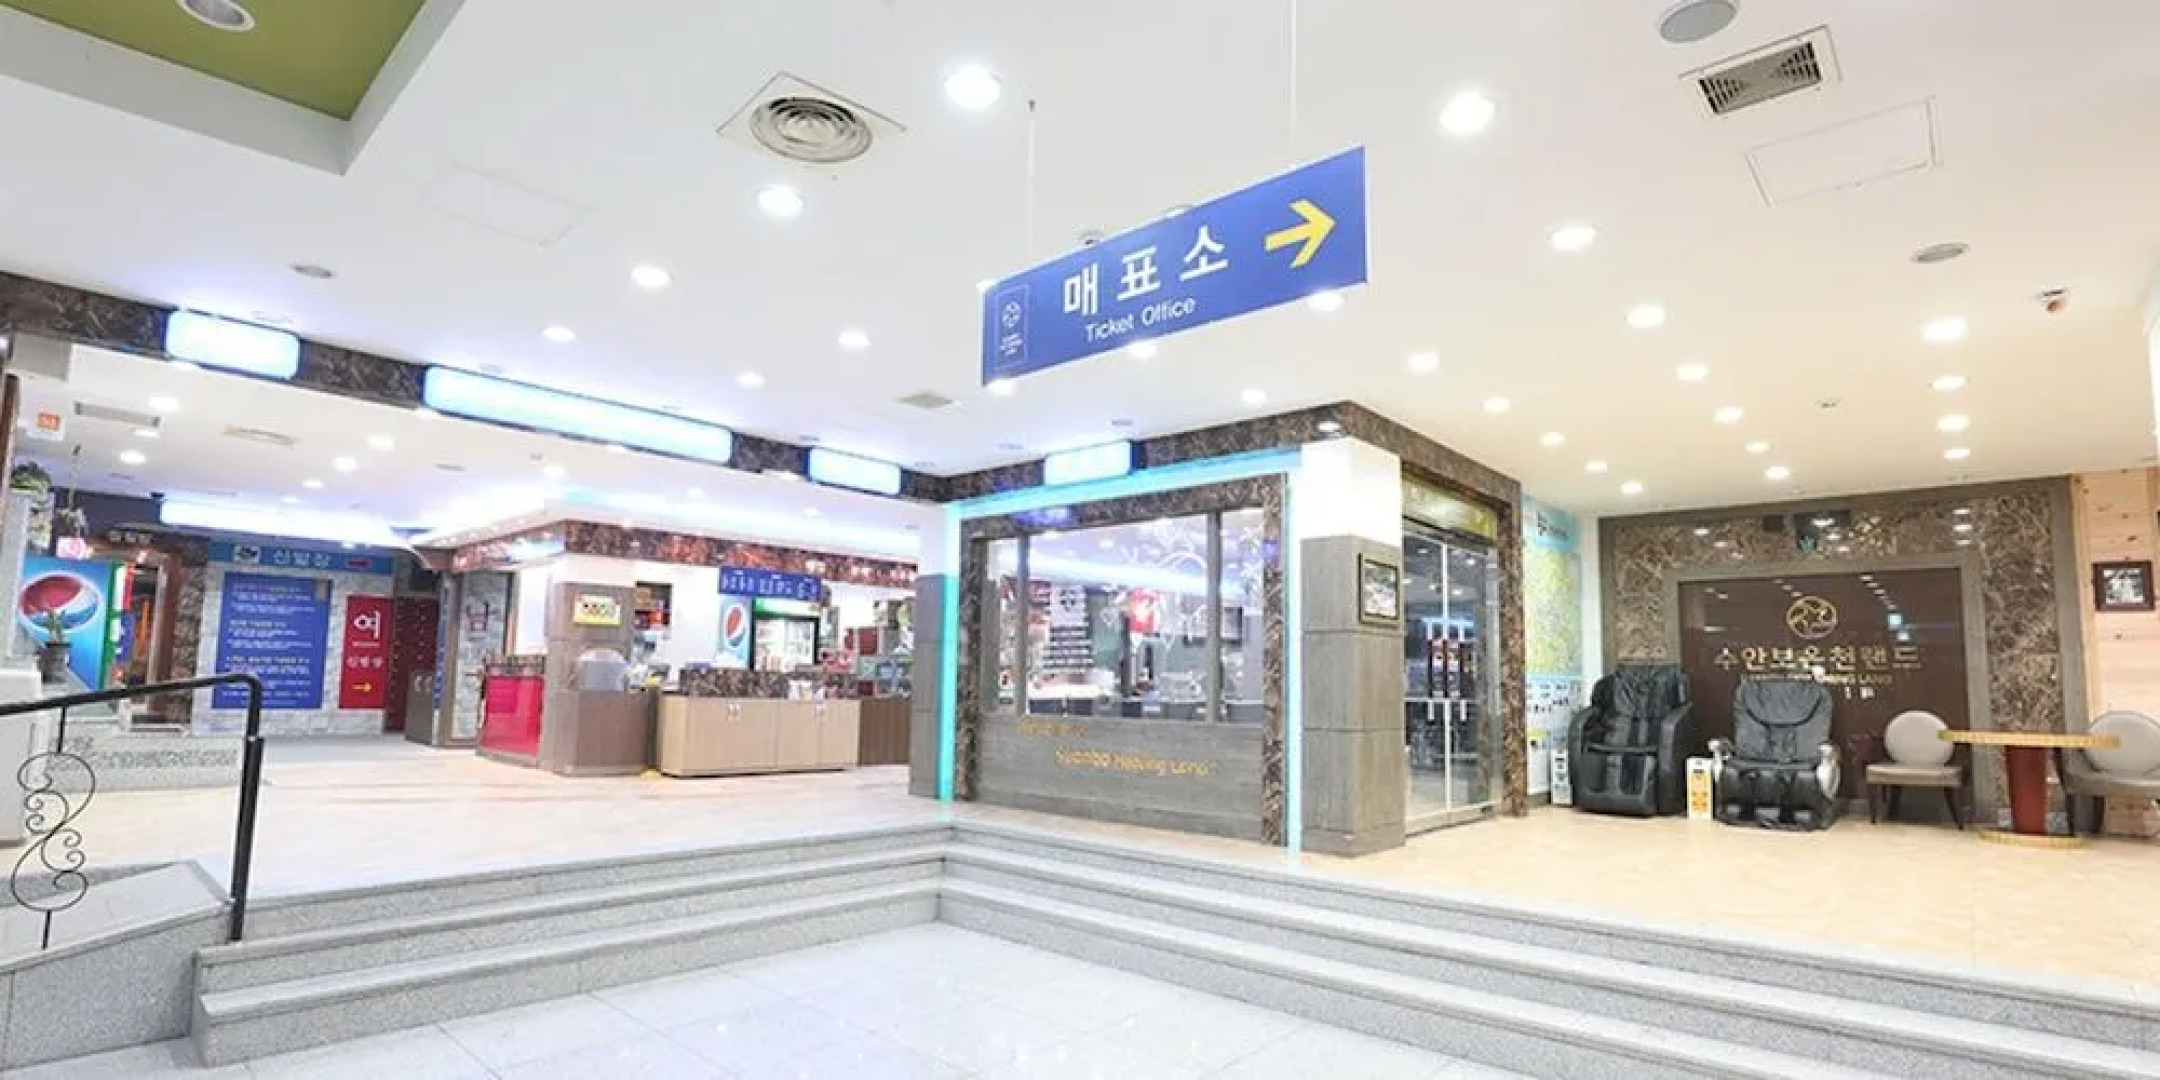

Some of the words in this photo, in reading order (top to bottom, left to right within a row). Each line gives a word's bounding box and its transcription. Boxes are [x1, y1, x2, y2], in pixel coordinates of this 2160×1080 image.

[1063, 223, 1229, 316] 매표소
[1085, 313, 1134, 343] Ticket
[1141, 295, 1196, 328] Office
[354, 609, 382, 640] 여
[1713, 644, 1923, 671] 수안보온천랜드
